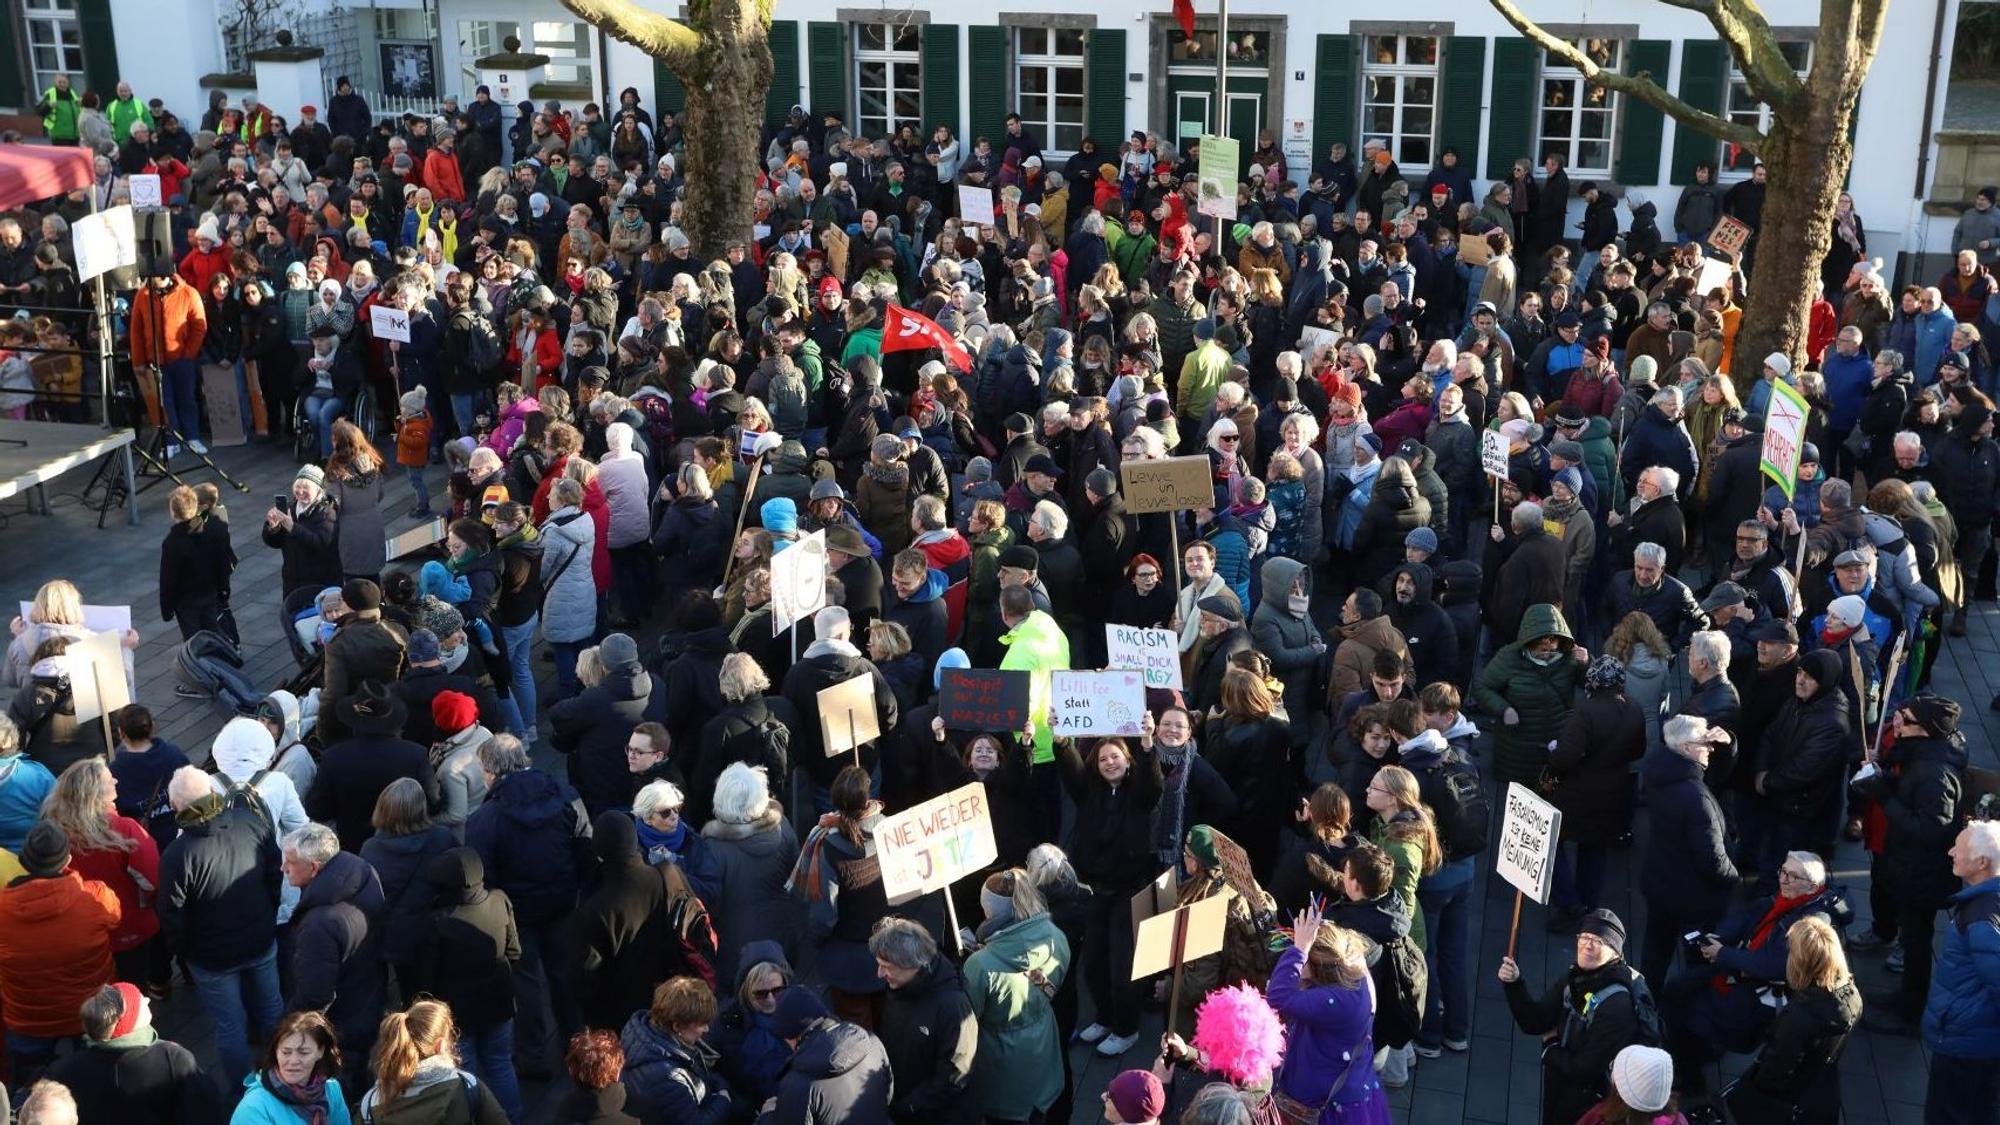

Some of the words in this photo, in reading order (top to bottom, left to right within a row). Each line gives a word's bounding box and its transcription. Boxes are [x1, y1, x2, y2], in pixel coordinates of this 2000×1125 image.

[1116, 629, 1168, 649] RACISM
[1146, 655, 1173, 668] DICK
[1065, 696, 1090, 709] statt
[1062, 715, 1093, 728] AFD
[1509, 794, 1550, 836] FASCHISMUS
[883, 821, 918, 855] NIE
[918, 796, 982, 838] WIEDER
[1500, 835, 1546, 892] MEINUNG!
